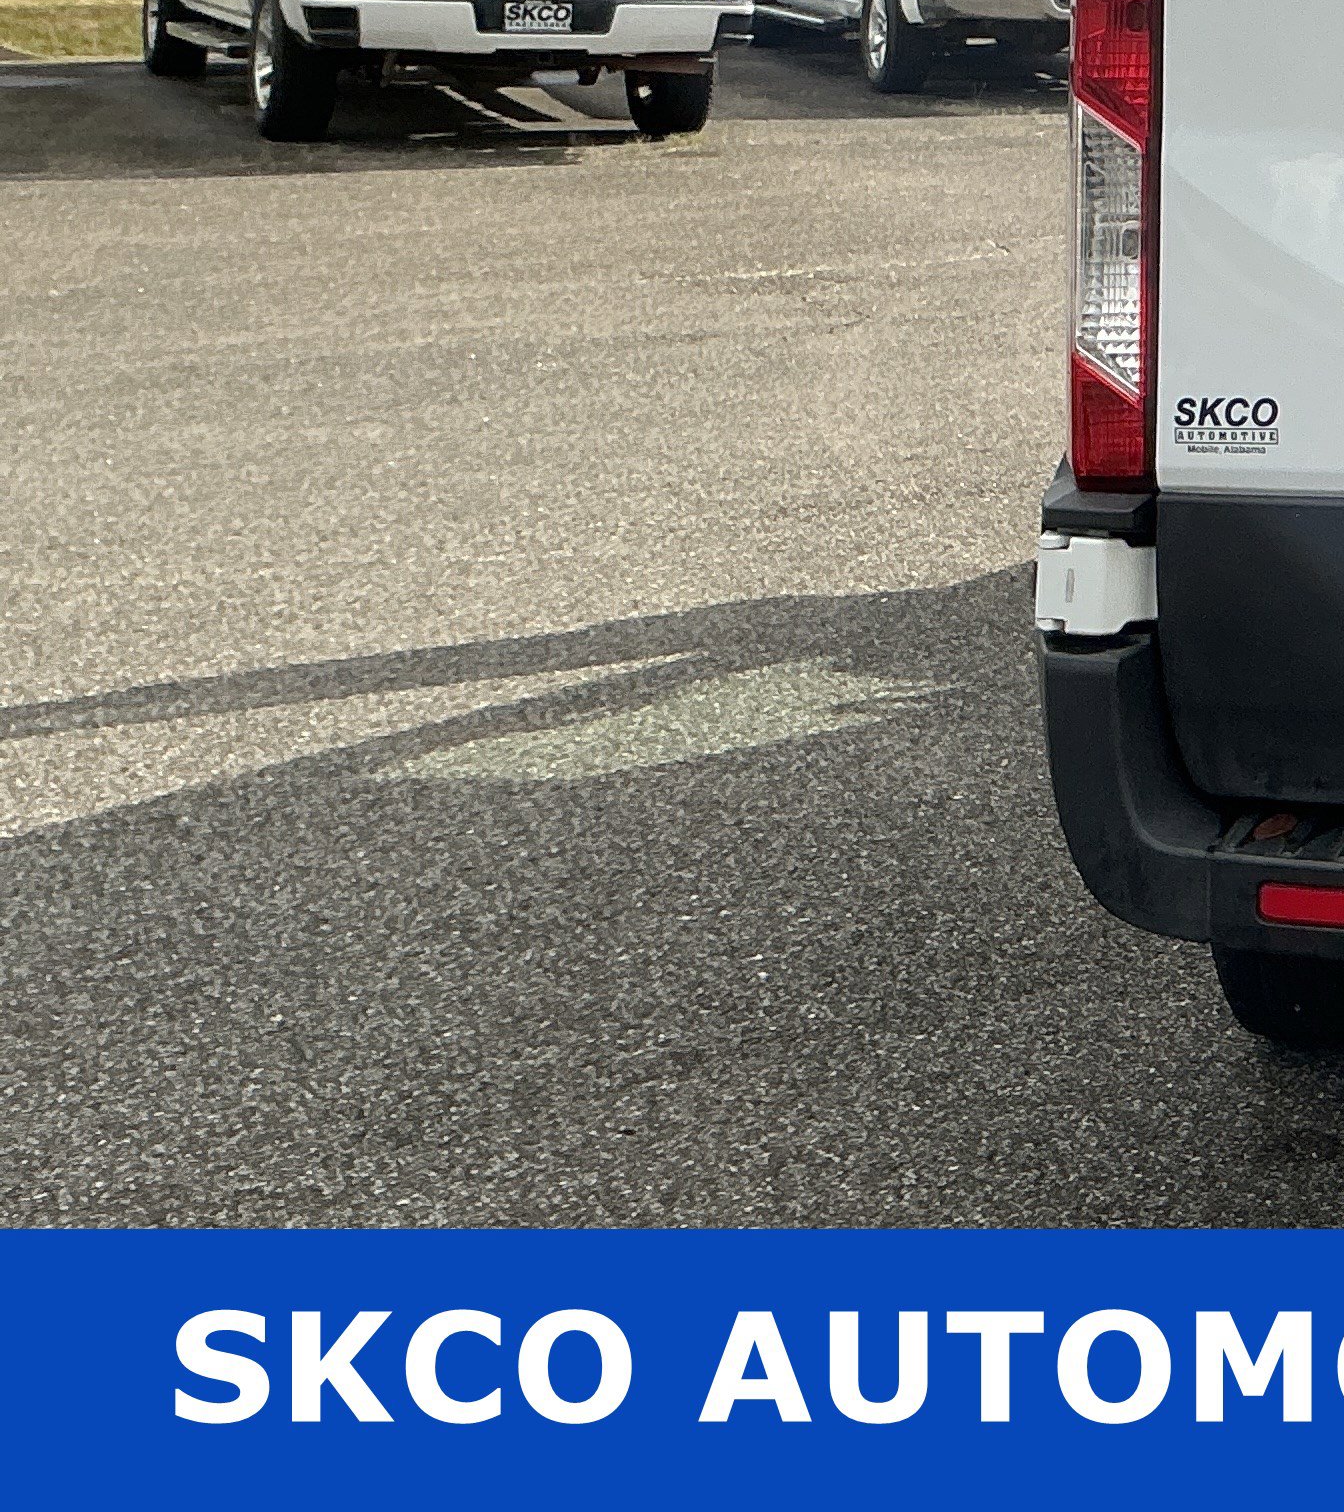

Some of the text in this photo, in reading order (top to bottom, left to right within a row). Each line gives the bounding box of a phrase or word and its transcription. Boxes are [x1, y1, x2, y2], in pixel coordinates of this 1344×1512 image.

[507, 5, 571, 21] SKCO
[1174, 397, 1279, 427] SKCO
[1177, 431, 1276, 441] AUTOMOTIVE
[1224, 445, 1266, 454] Alabama
